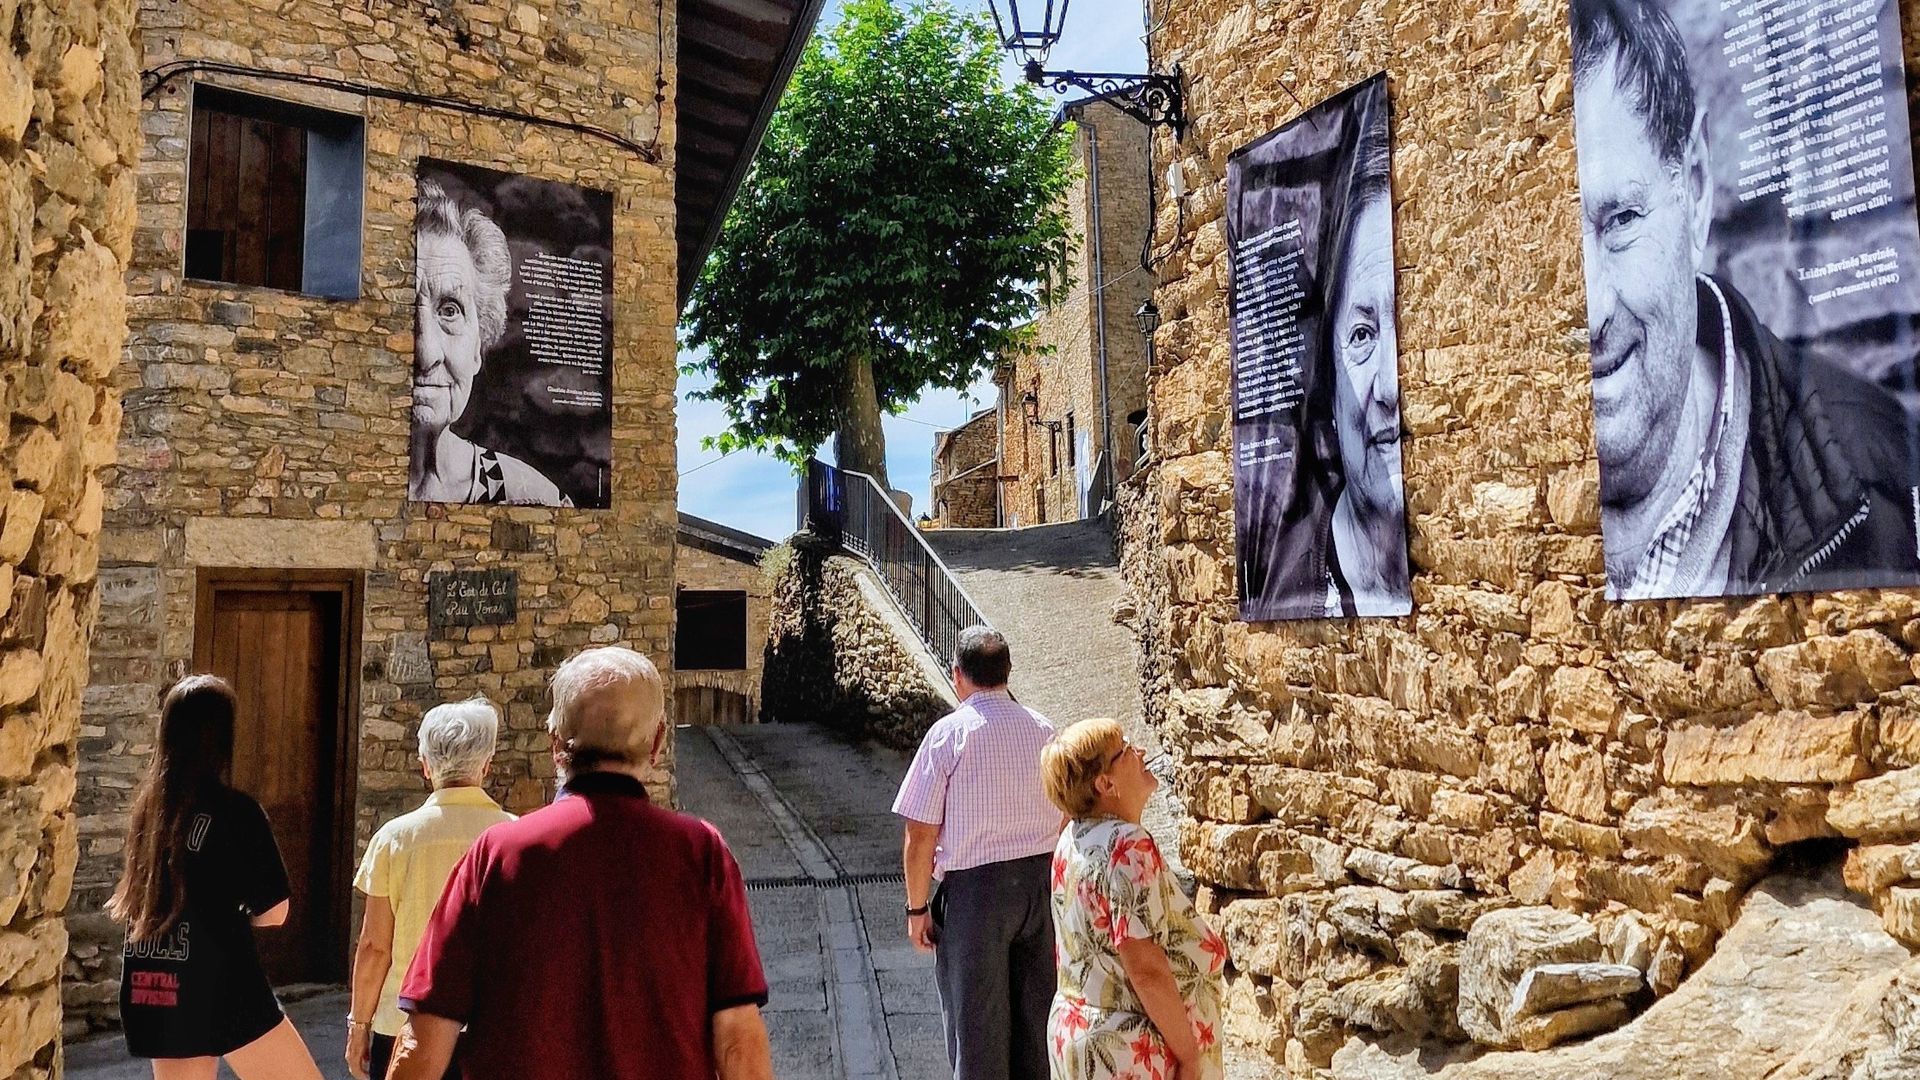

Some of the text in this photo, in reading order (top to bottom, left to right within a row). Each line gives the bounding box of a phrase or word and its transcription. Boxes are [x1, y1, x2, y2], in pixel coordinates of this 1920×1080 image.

[1833, 7, 1851, 22] vaig
[1837, 26, 1851, 38] que
[1774, 68, 1788, 81] per
[1828, 45, 1843, 58] que
[1844, 39, 1857, 50] era
[1858, 29, 1878, 44] molt
[1777, 83, 1791, 96] per
[1859, 45, 1879, 60] molt
[1862, 61, 1881, 76] vaig
[1773, 116, 1788, 129] pas
[1805, 102, 1822, 115] que
[1810, 114, 1832, 127] vaig
[1870, 111, 1885, 125] per
[1821, 146, 1833, 158] dir
[1834, 141, 1848, 154] que
[1865, 129, 1887, 144] quan
[1833, 159, 1847, 170] van
[1842, 186, 1856, 201] qui
[131, 971, 180, 989] CENTRAL
